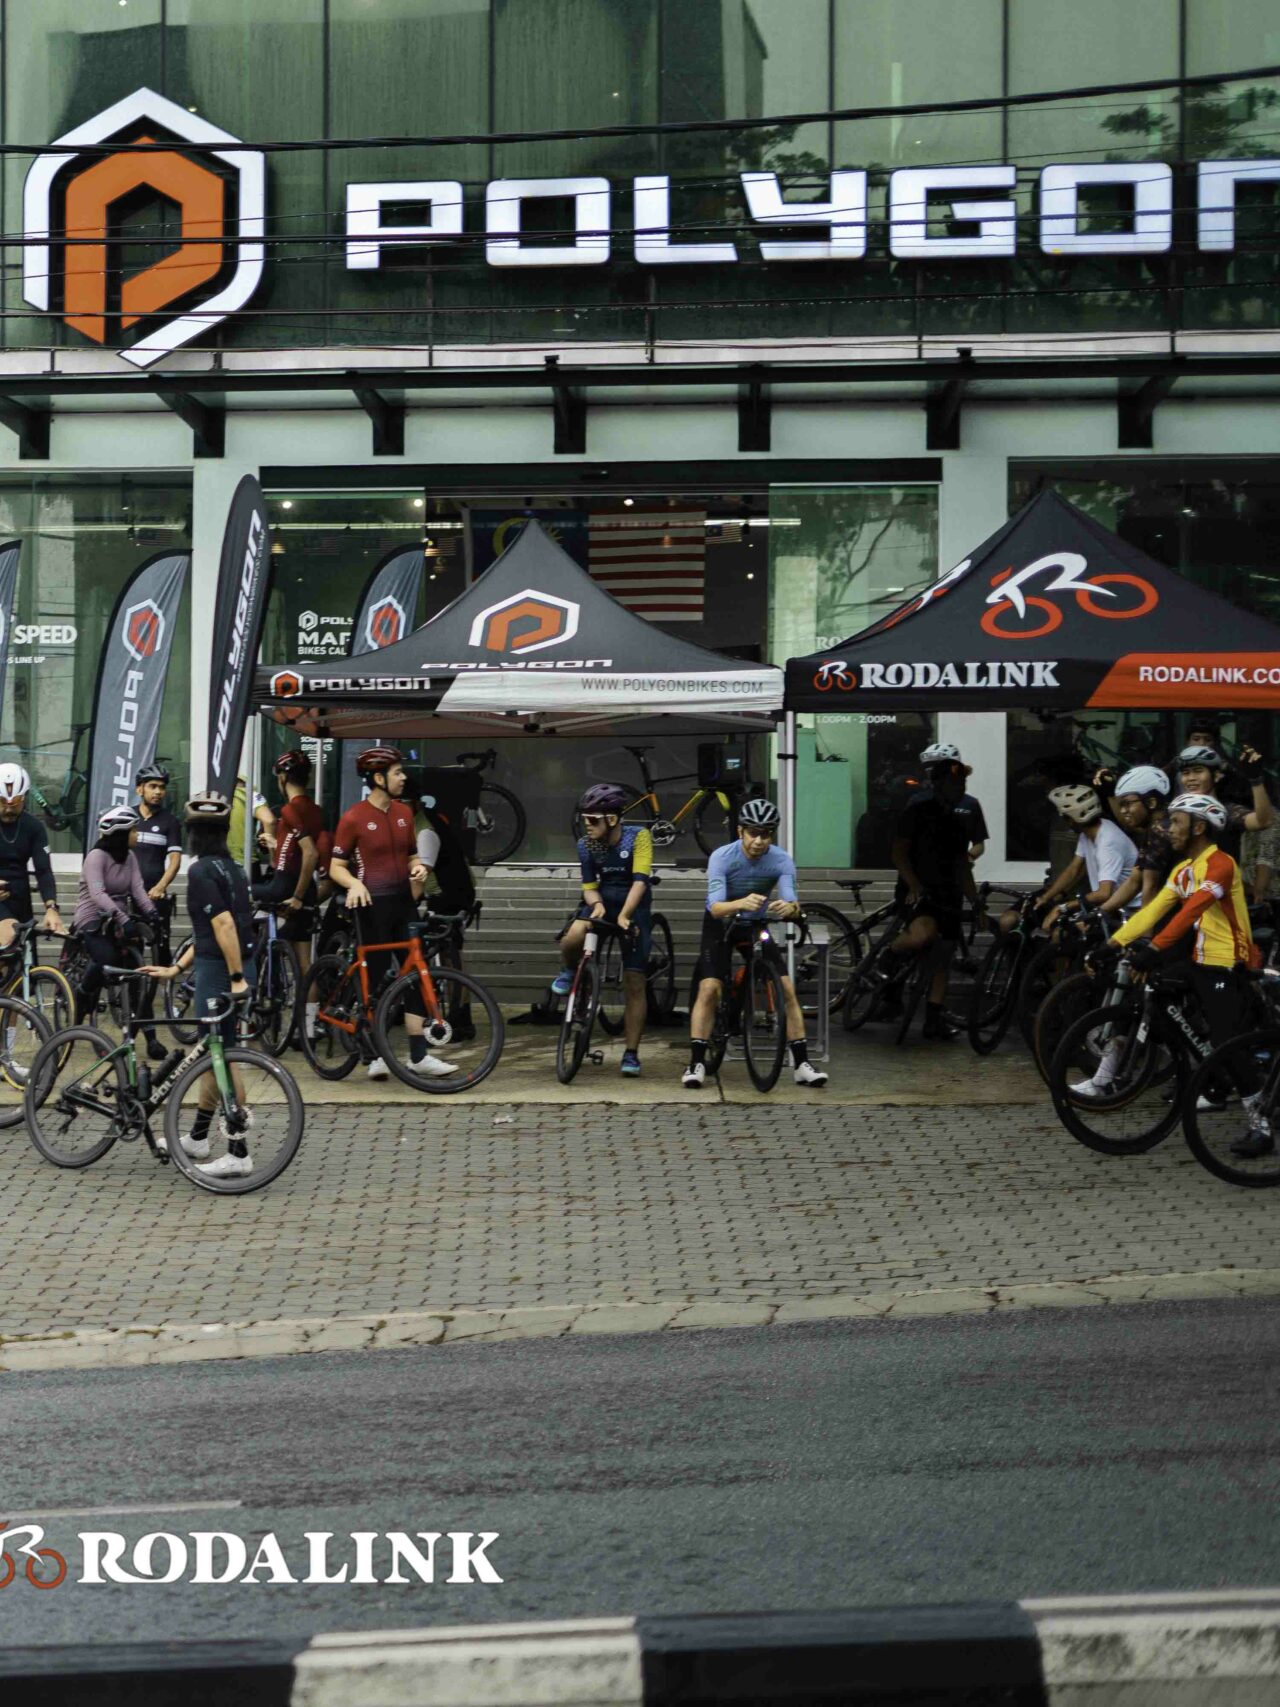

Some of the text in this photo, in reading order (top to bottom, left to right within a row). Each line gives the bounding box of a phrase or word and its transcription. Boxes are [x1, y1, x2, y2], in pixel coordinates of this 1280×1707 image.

[13, 625, 78, 645] SPEED
[212, 509, 262, 778] POLYGON
[33, 656, 46, 664] UP
[298, 646, 327, 655] BIKES
[420, 658, 614, 670] POLYGON
[308, 677, 431, 692] POLYGON
[859, 661, 1061, 689] RODALINK
[580, 676, 764, 695] WWW.POLYGONBIKES.COM
[1167, 1005, 1211, 1057] CIPOLLIN
[149, 1041, 206, 1105] POLYGON
